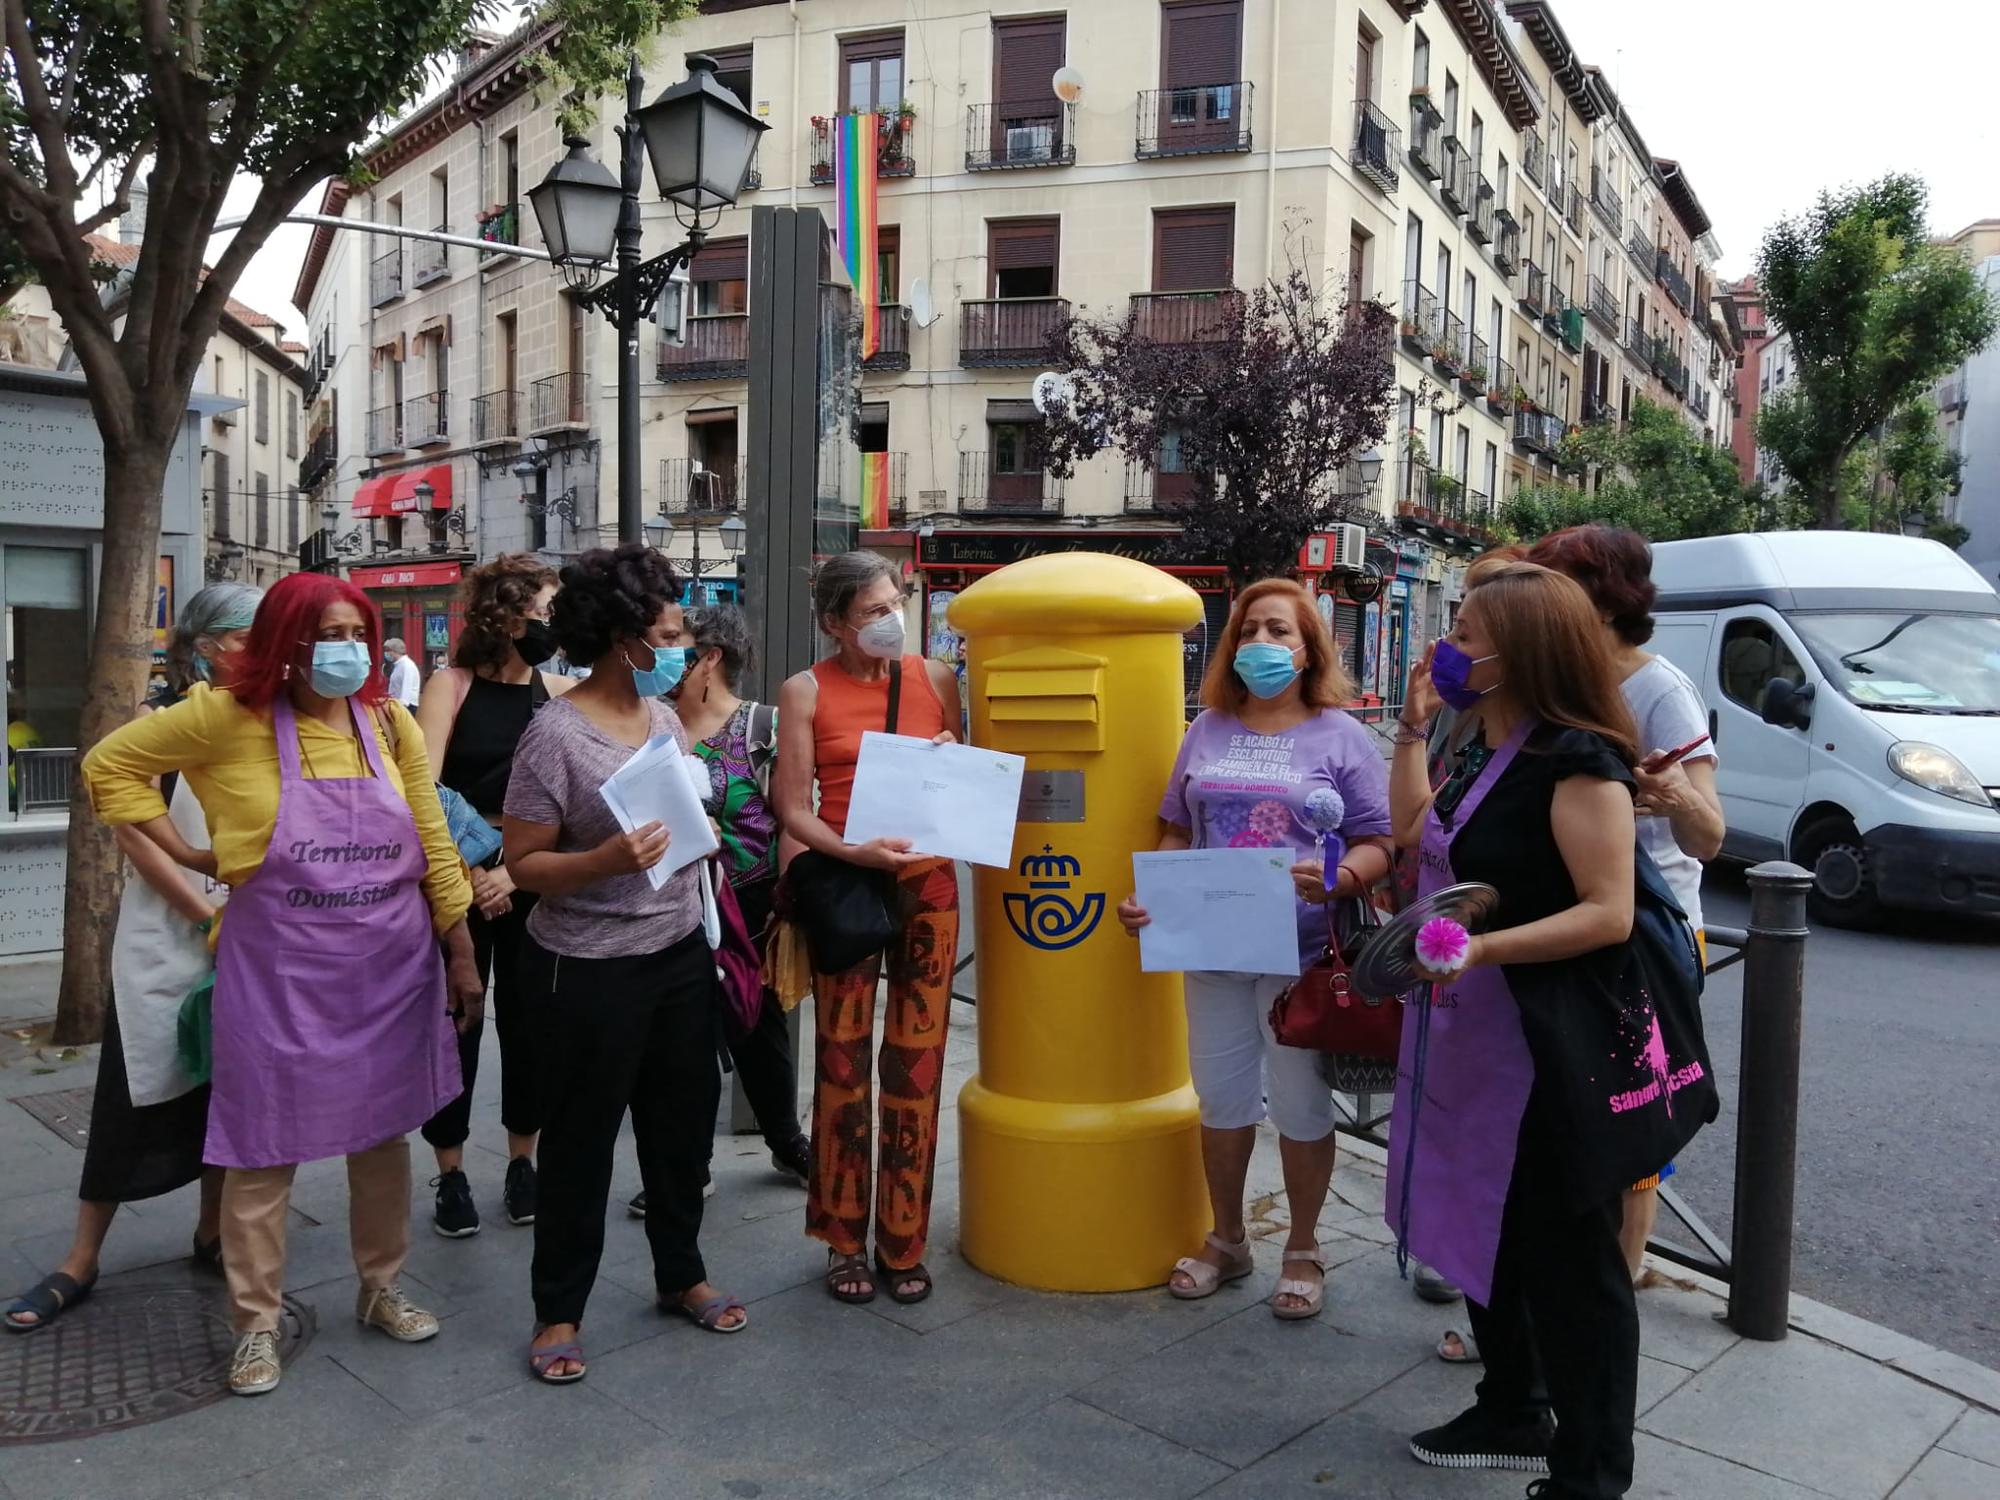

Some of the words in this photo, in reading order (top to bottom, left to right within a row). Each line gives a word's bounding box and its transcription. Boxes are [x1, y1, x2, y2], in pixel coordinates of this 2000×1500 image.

[950, 542, 997, 560] Taberna
[1230, 734, 1243, 747] SE
[1243, 734, 1280, 748] ACABÓ
[1280, 738, 1295, 750] LA
[1227, 747, 1292, 763] ESCLAVITUD!
[1263, 762, 1278, 773] EN
[289, 839, 403, 863] Territorio
